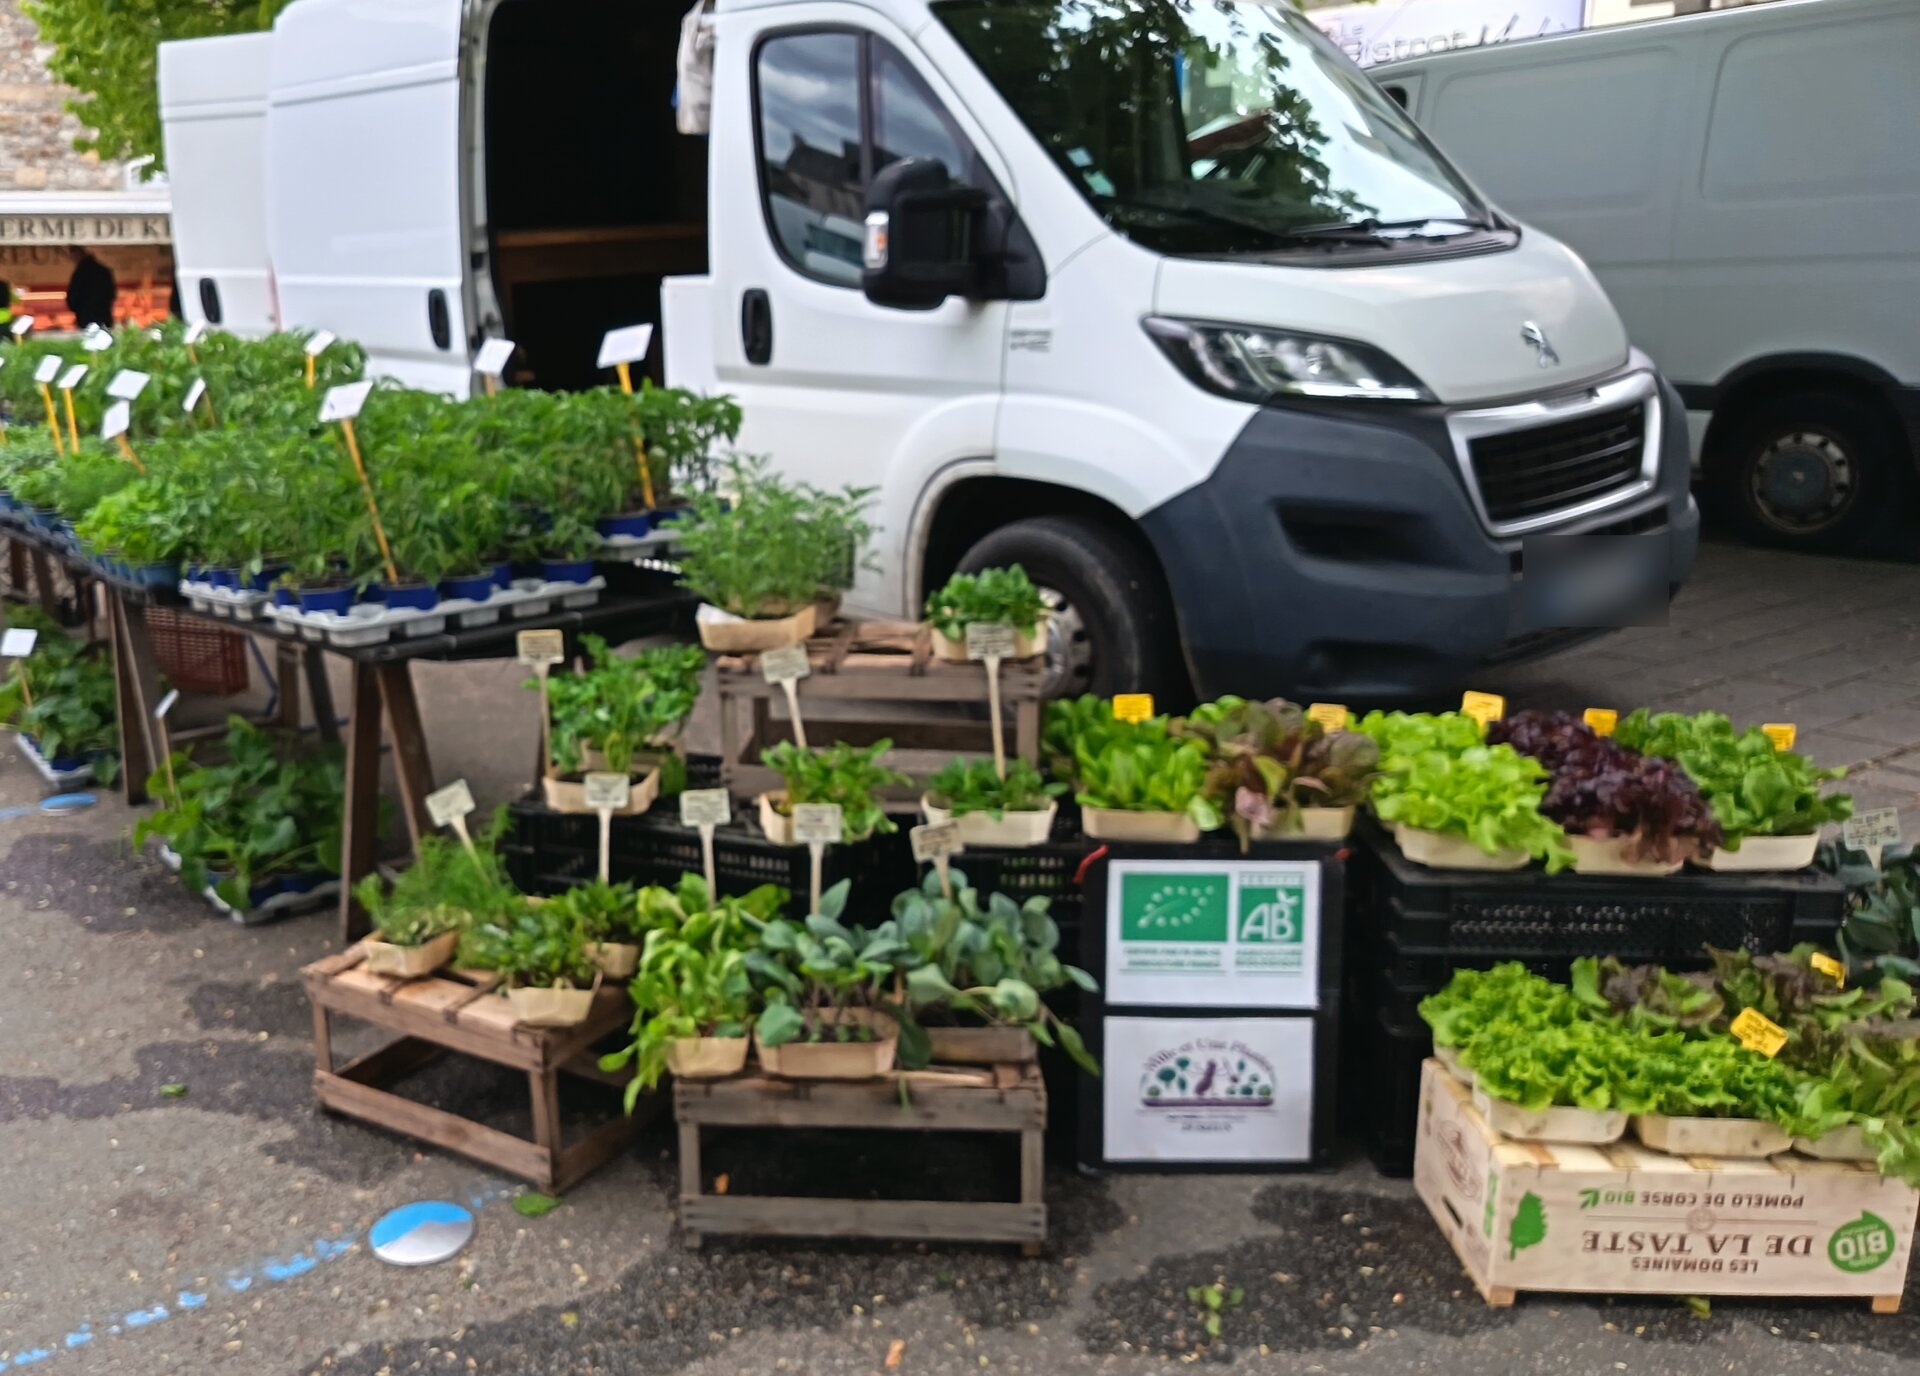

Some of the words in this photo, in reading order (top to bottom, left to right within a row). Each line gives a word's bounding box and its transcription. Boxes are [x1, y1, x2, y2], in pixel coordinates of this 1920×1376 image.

[94, 217, 133, 238] DE
[143, 217, 171, 238] K
[1241, 902, 1296, 940] AB
[1603, 1190, 1636, 1205] BIO
[1640, 1190, 1698, 1207] CORSE
[1702, 1192, 1726, 1208] DE
[1731, 1193, 1805, 1209] POMELO
[1581, 1230, 1692, 1255] TASTE
[1706, 1232, 1753, 1256] LA
[1765, 1233, 1816, 1257] DE
[1835, 1229, 1888, 1262] BIO
[1631, 1256, 1723, 1273] DOMAINES
[1729, 1258, 1759, 1274] LES
